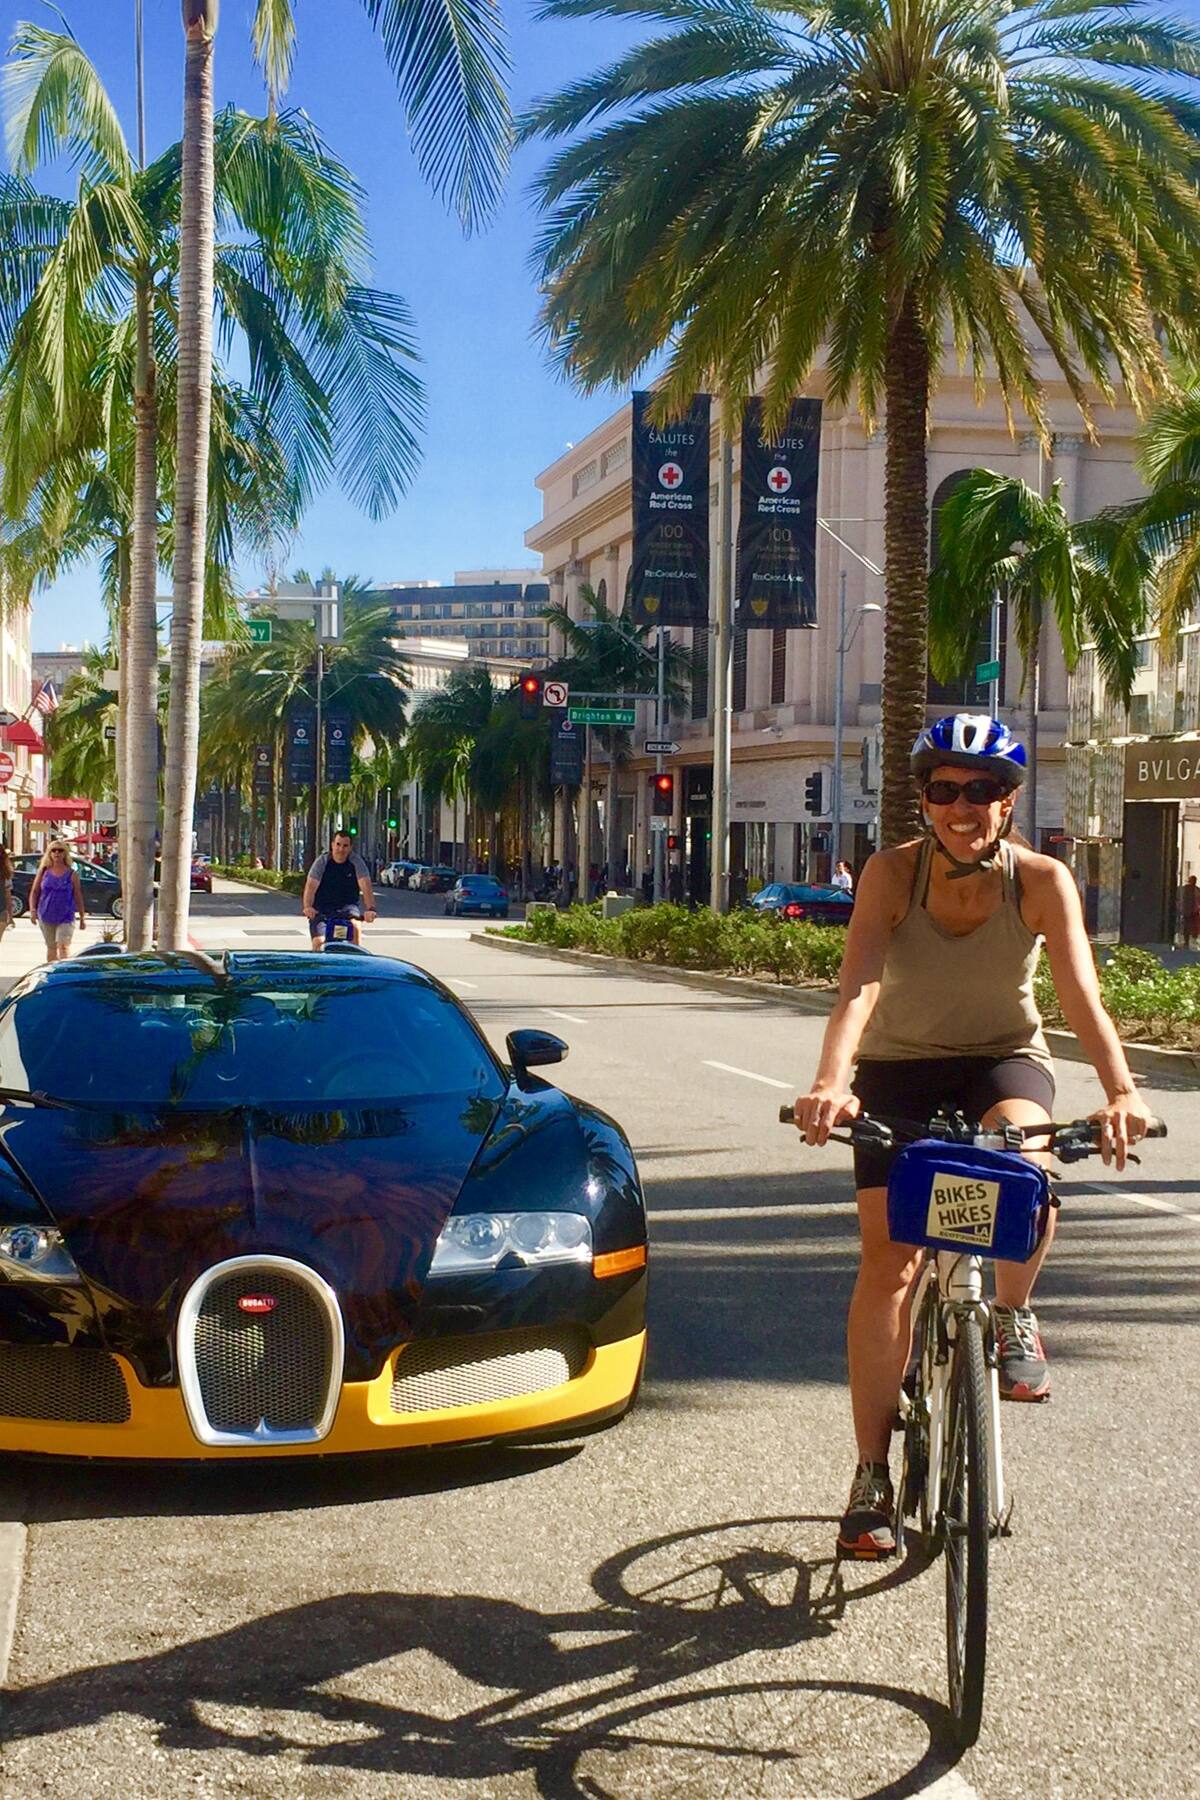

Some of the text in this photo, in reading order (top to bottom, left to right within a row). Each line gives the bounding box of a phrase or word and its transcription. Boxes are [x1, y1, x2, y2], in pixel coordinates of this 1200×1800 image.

[648, 432, 695, 446] SALUTES
[664, 448, 678, 457] the
[650, 492, 693, 501] American
[758, 495, 801, 505] American
[649, 500, 693, 510] Red Cross
[757, 504, 801, 514] Red Cross
[660, 524, 684, 539] 100
[572, 711, 633, 722] Brighton Way
[934, 1183, 987, 1205] BIKES
[938, 1204, 992, 1226] HIKES
[974, 1225, 989, 1237] LA
